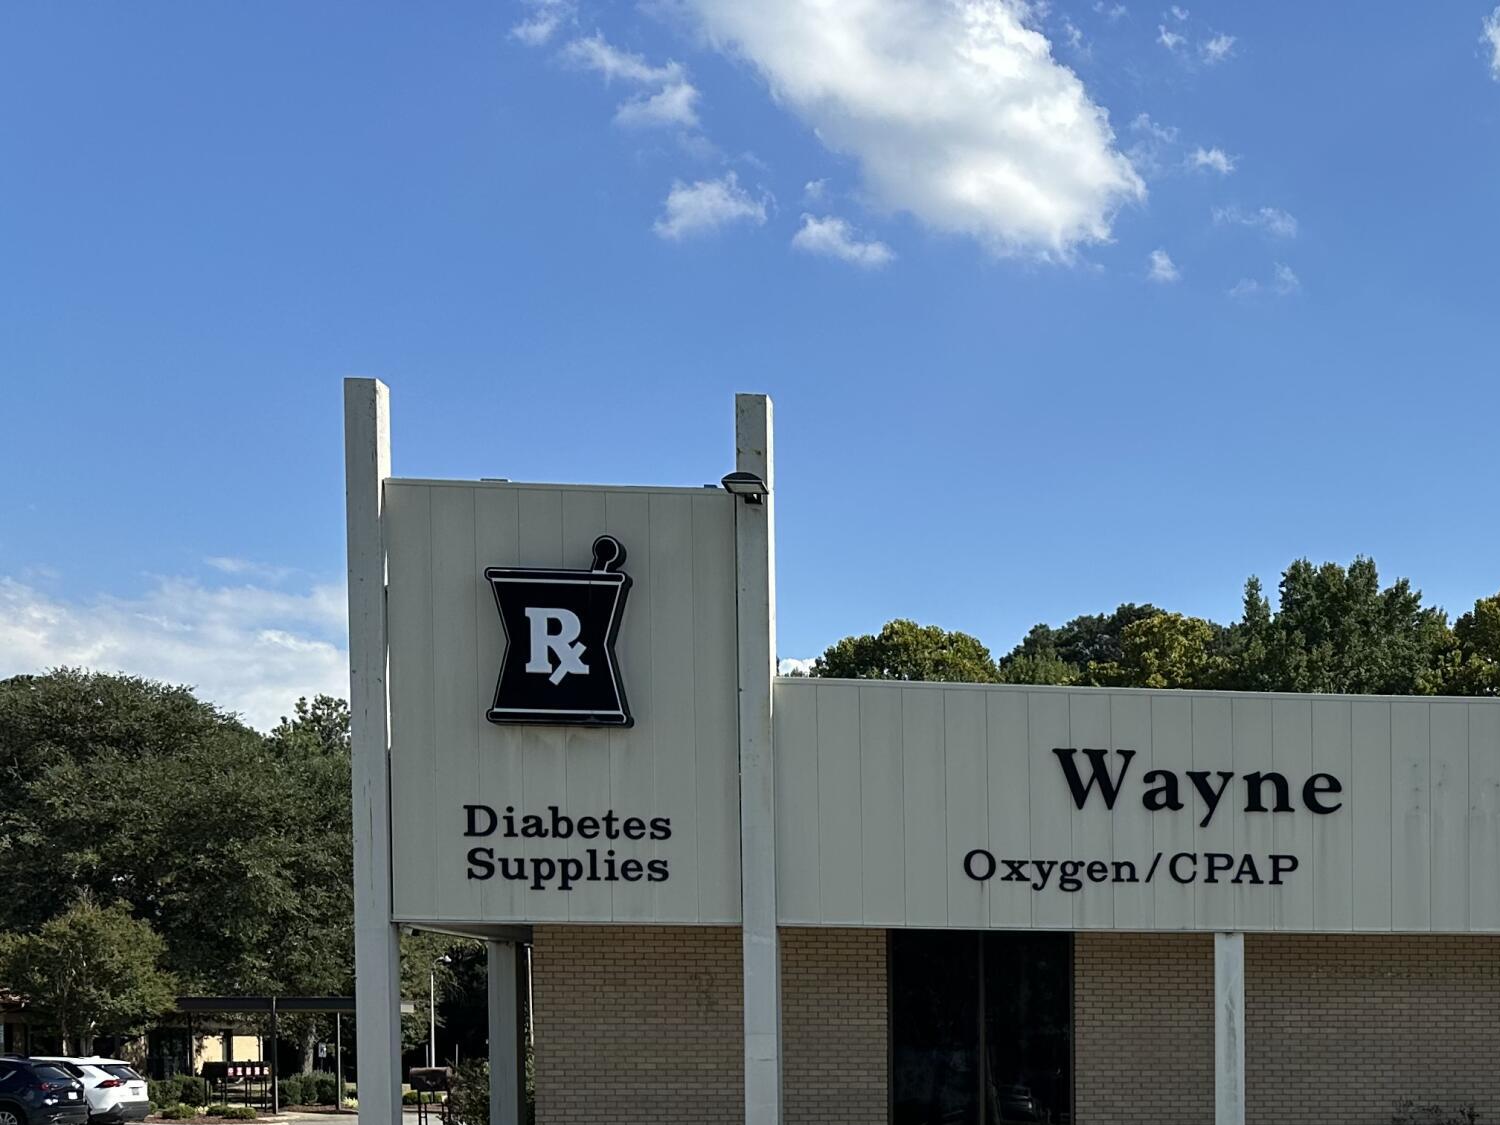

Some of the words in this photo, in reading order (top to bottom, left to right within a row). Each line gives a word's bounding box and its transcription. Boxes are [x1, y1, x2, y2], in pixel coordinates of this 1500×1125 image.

[1051, 747, 1343, 828] Wayne
[462, 804, 673, 841] Diabetes
[466, 847, 670, 891] Supplies
[963, 848, 1300, 893] Oxygen/CPAP
